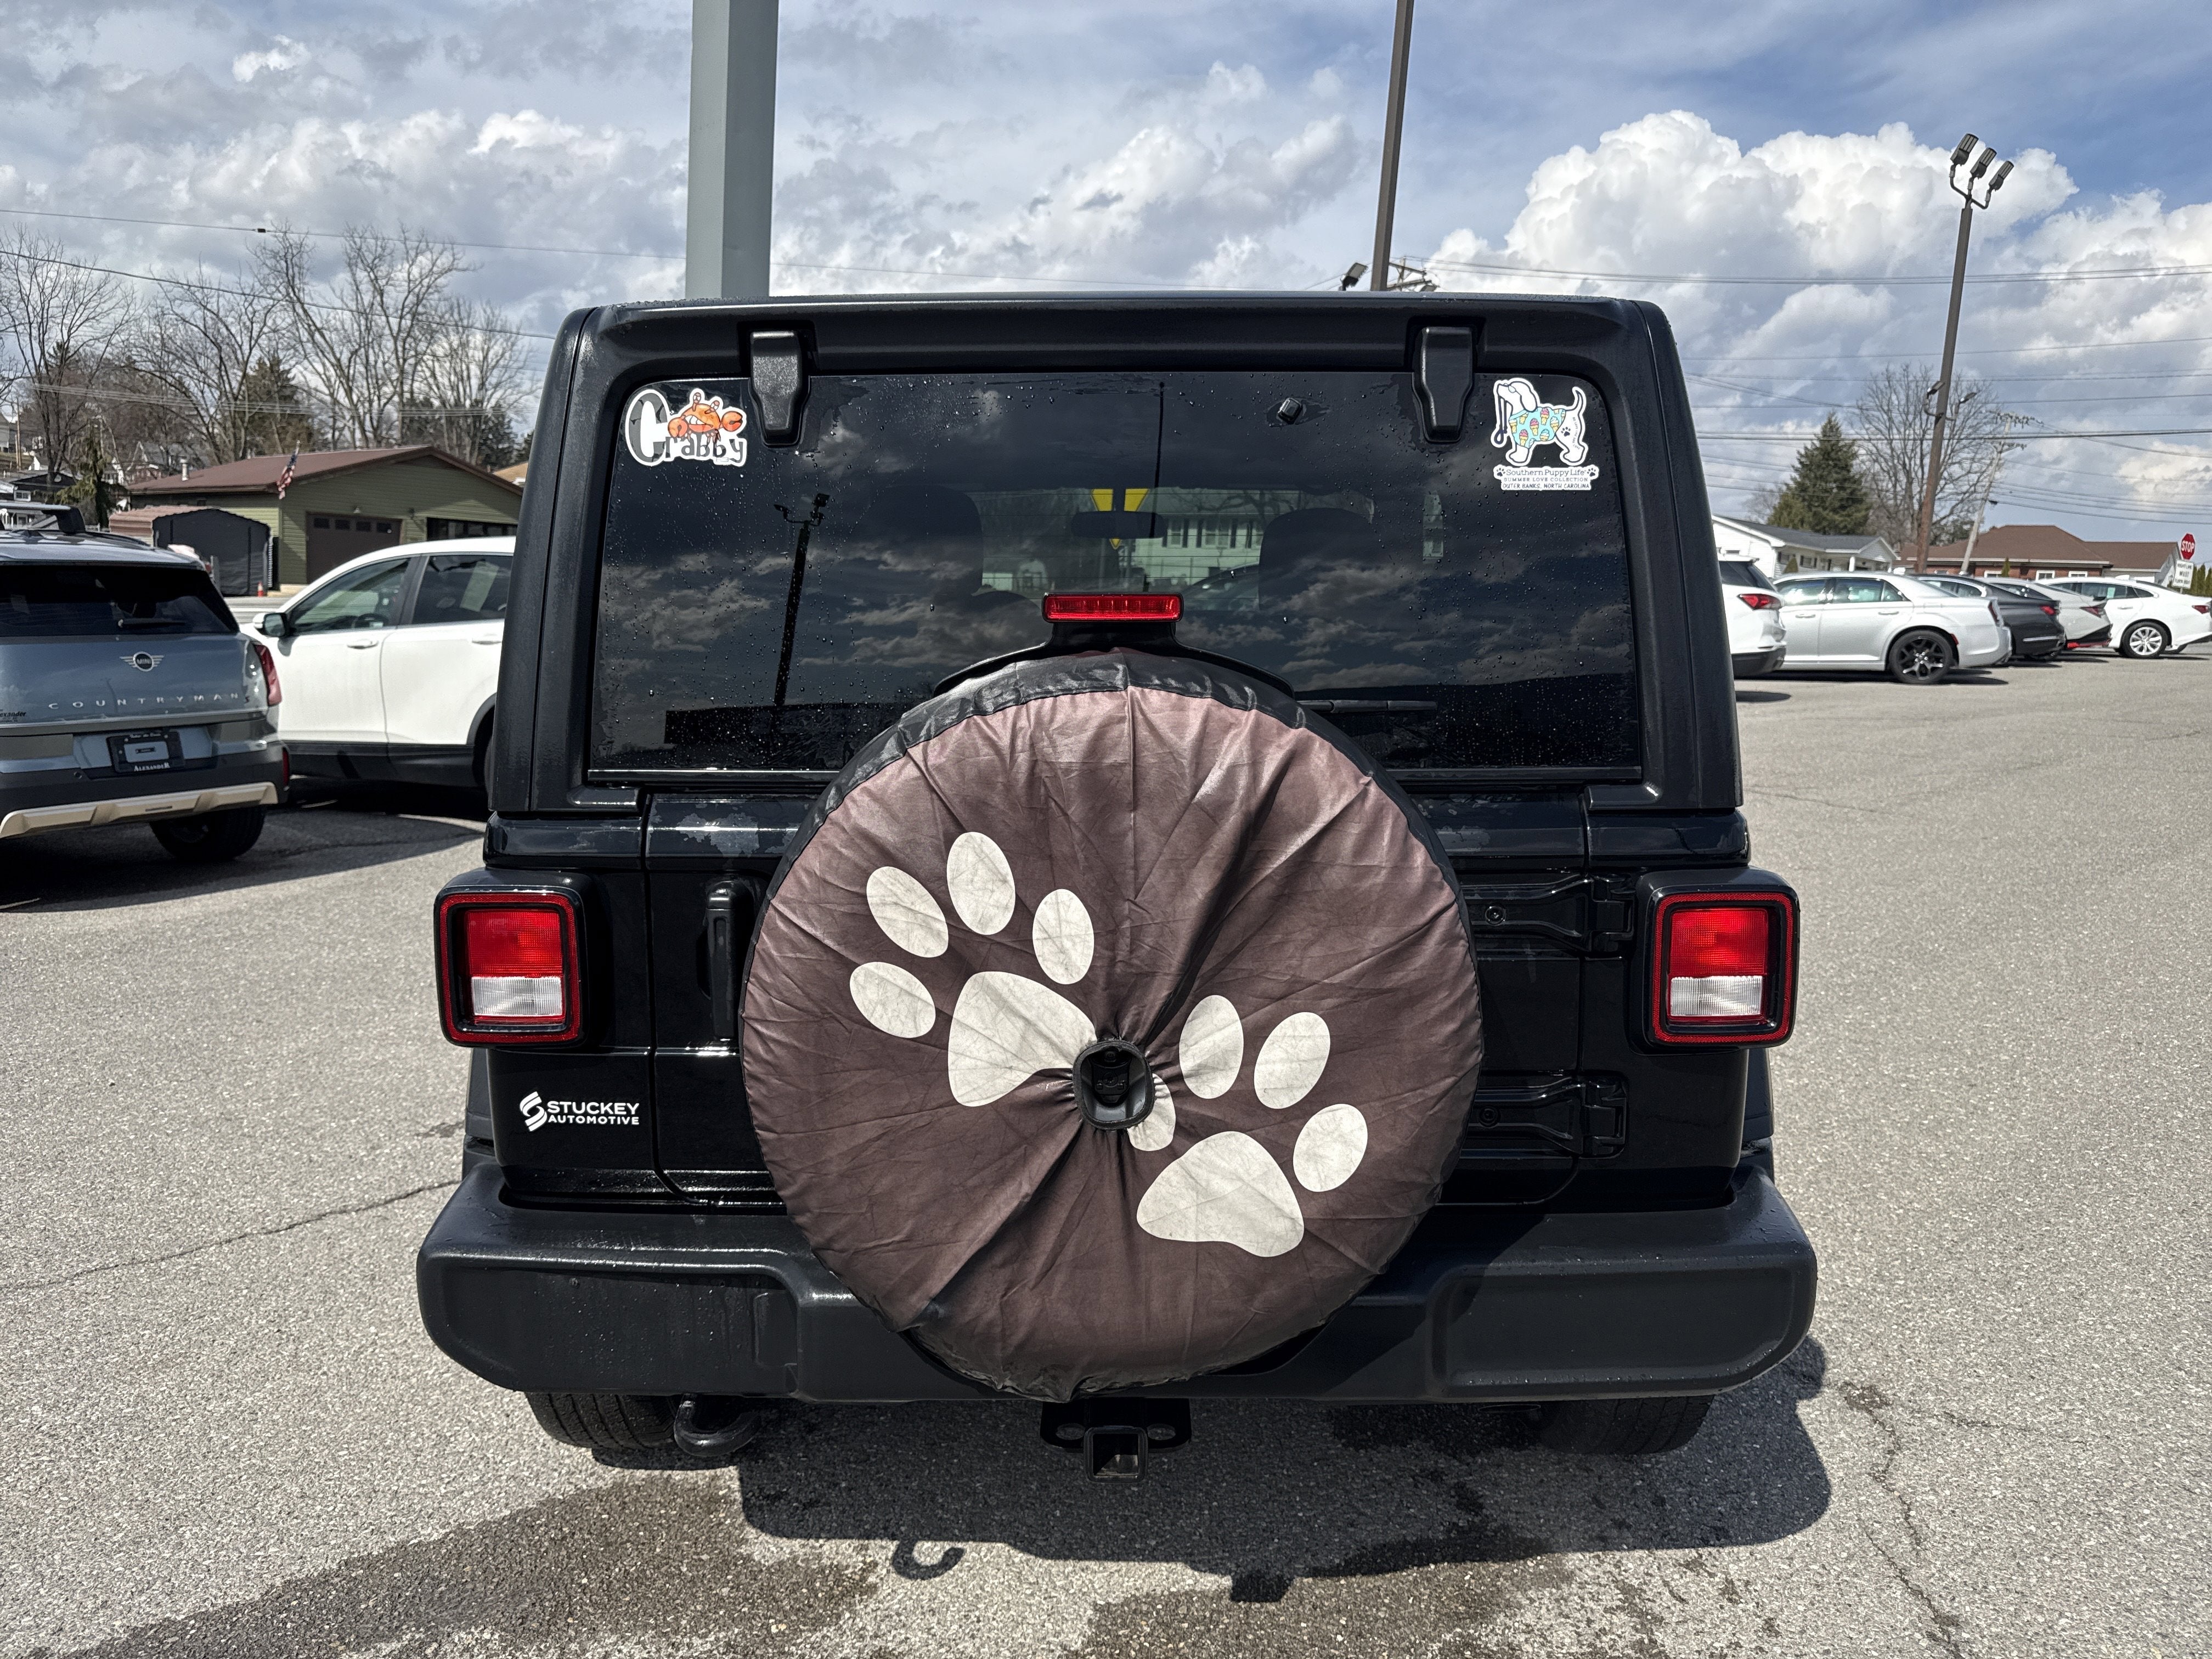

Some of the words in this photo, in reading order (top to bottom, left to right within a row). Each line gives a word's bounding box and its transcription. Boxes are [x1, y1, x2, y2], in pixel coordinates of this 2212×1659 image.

[628, 392, 743, 464] Crabby
[2181, 540, 2194, 552] STOP
[48, 693, 239, 709] COUNTRYMAN
[547, 1101, 640, 1115] STUCKEY
[548, 1115, 640, 1125] AUTOMOTIVE
